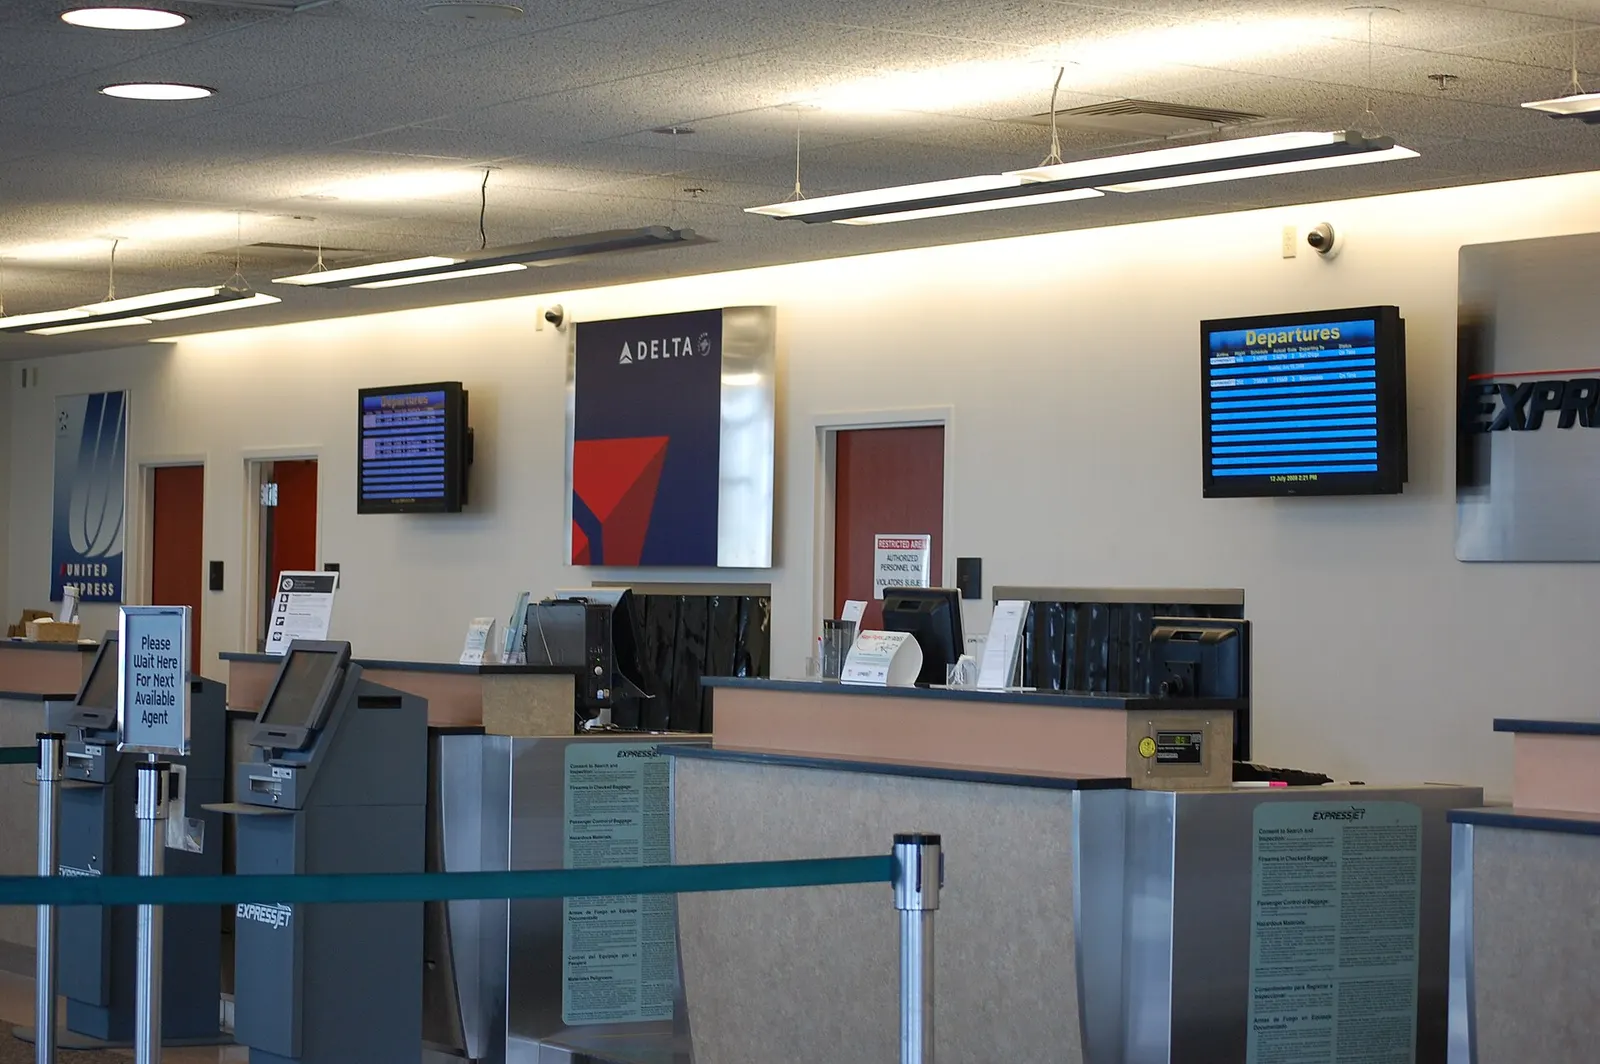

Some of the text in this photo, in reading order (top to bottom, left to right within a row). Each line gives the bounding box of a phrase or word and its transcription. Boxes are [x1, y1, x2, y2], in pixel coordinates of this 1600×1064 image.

[1246, 327, 1340, 348] Departures
[637, 336, 693, 360] DELTA
[878, 540, 909, 548] RESTRICTED
[66, 563, 107, 576] UNITED
[880, 564, 908, 572] PERSONNEL
[66, 582, 114, 596] PRESS
[142, 636, 170, 650] Please
[134, 653, 178, 669] Wait Here
[136, 673, 174, 688] For Next
[135, 692, 175, 706] Available
[142, 710, 168, 728] Agent
[1312, 809, 1365, 822] EXPRESSJET
[236, 903, 291, 929] EXPRESSJET
